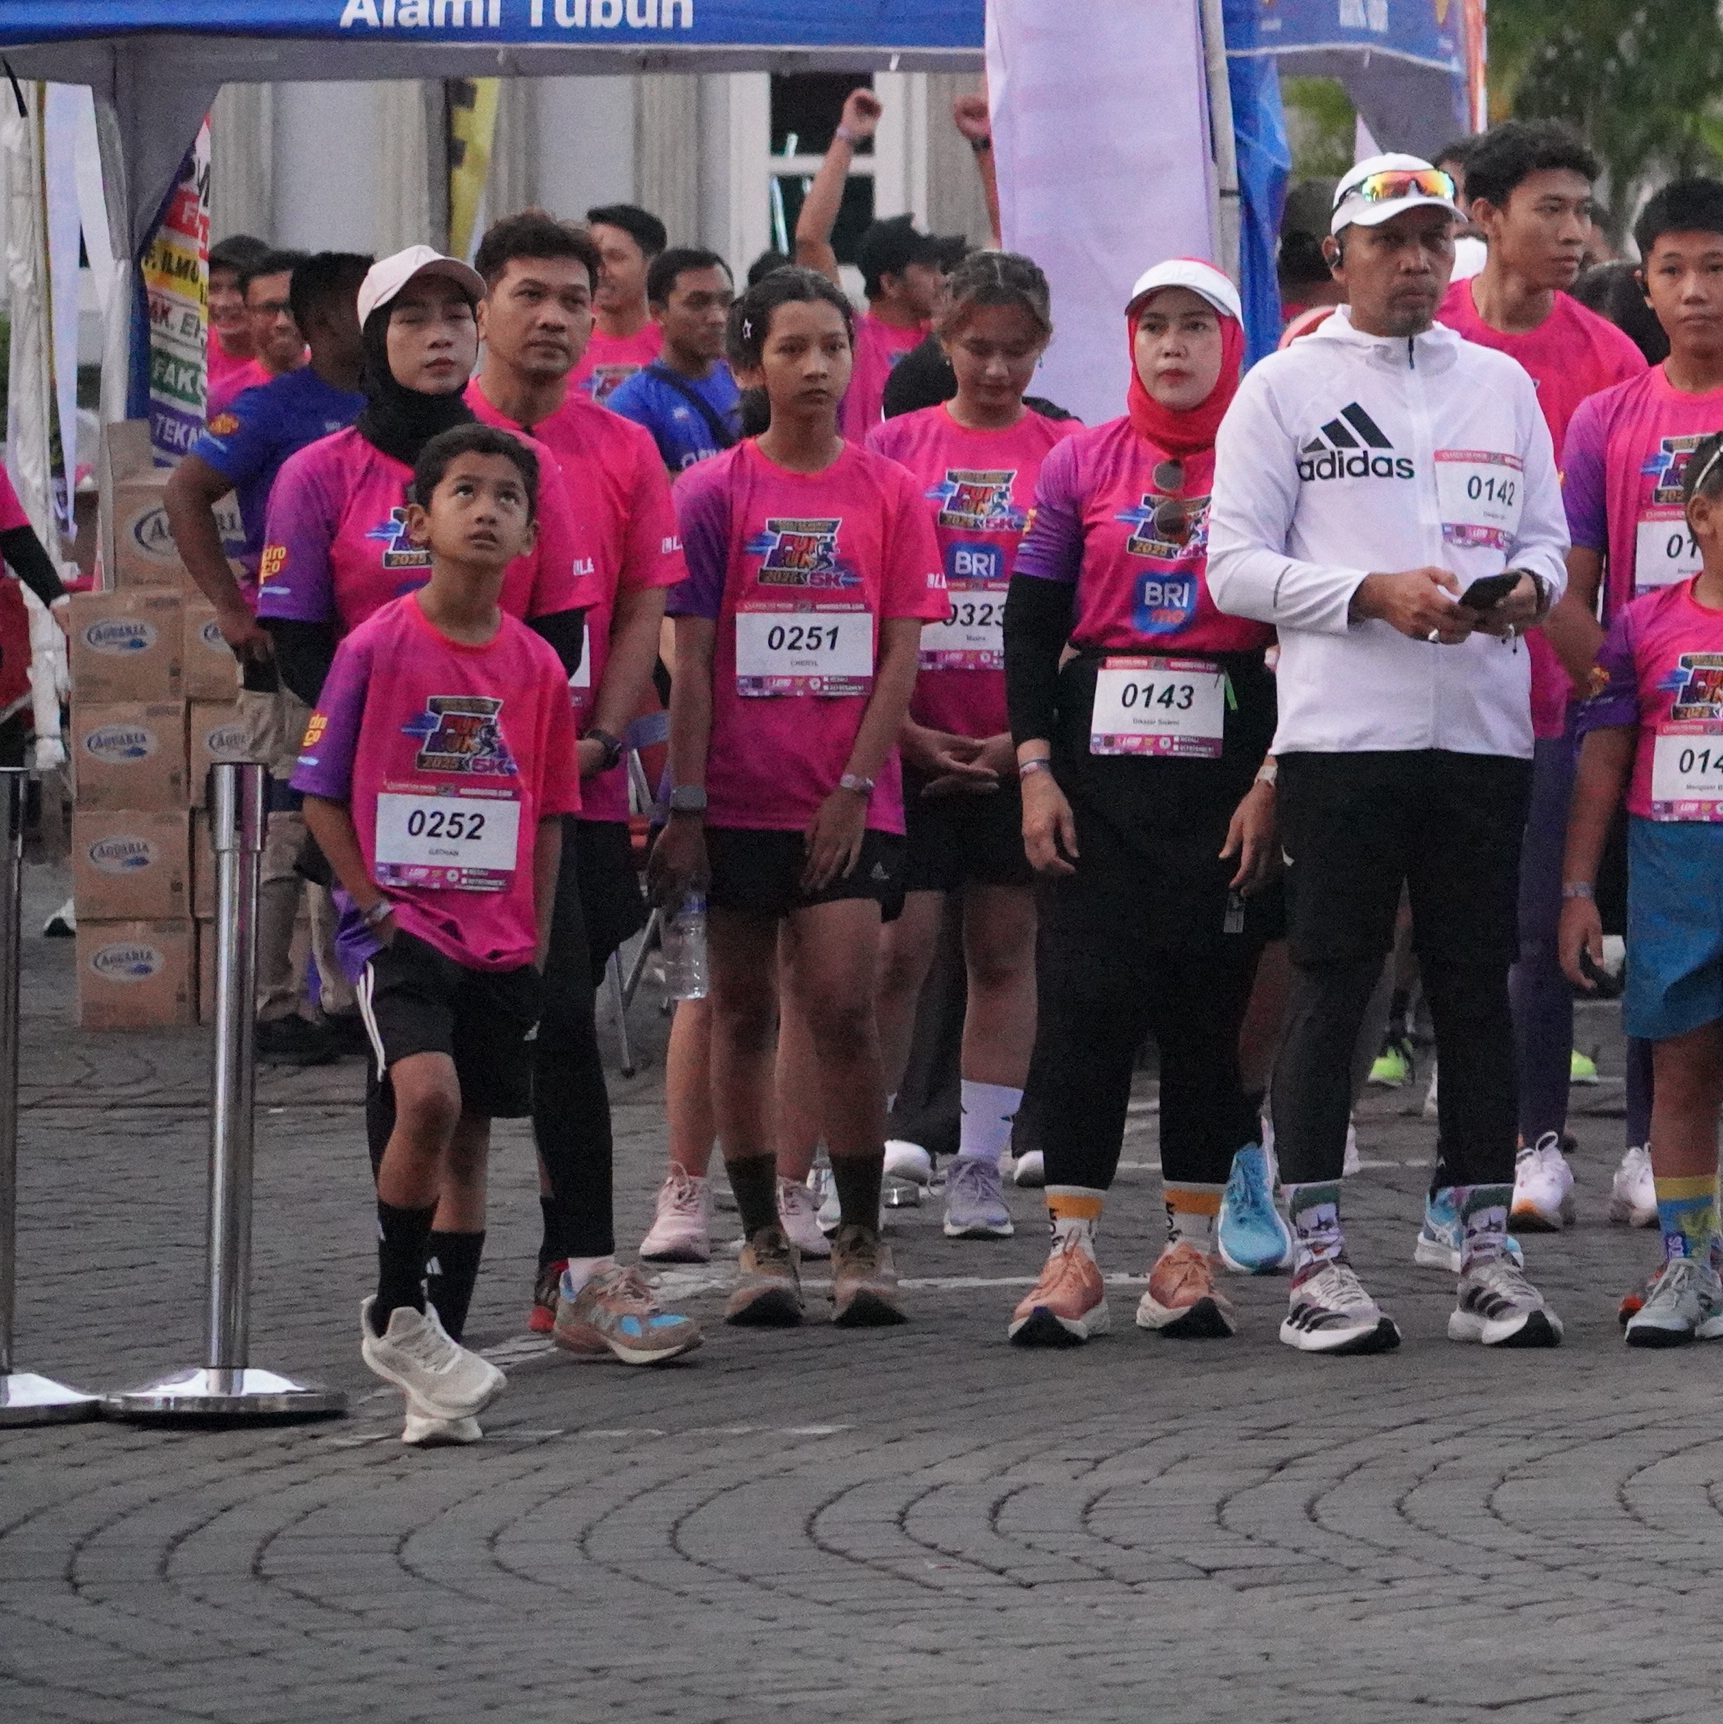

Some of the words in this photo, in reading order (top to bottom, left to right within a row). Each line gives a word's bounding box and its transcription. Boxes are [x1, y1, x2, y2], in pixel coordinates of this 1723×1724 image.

[1297, 450, 1415, 482] adidas
[1467, 475, 1515, 507] 0142
[1666, 533, 1701, 559] 01
[954, 551, 996, 577] BRI
[1144, 580, 1190, 608] BRI
[767, 625, 840, 651] 0251
[1121, 682, 1195, 711] 0143
[407, 809, 486, 841] 0252
